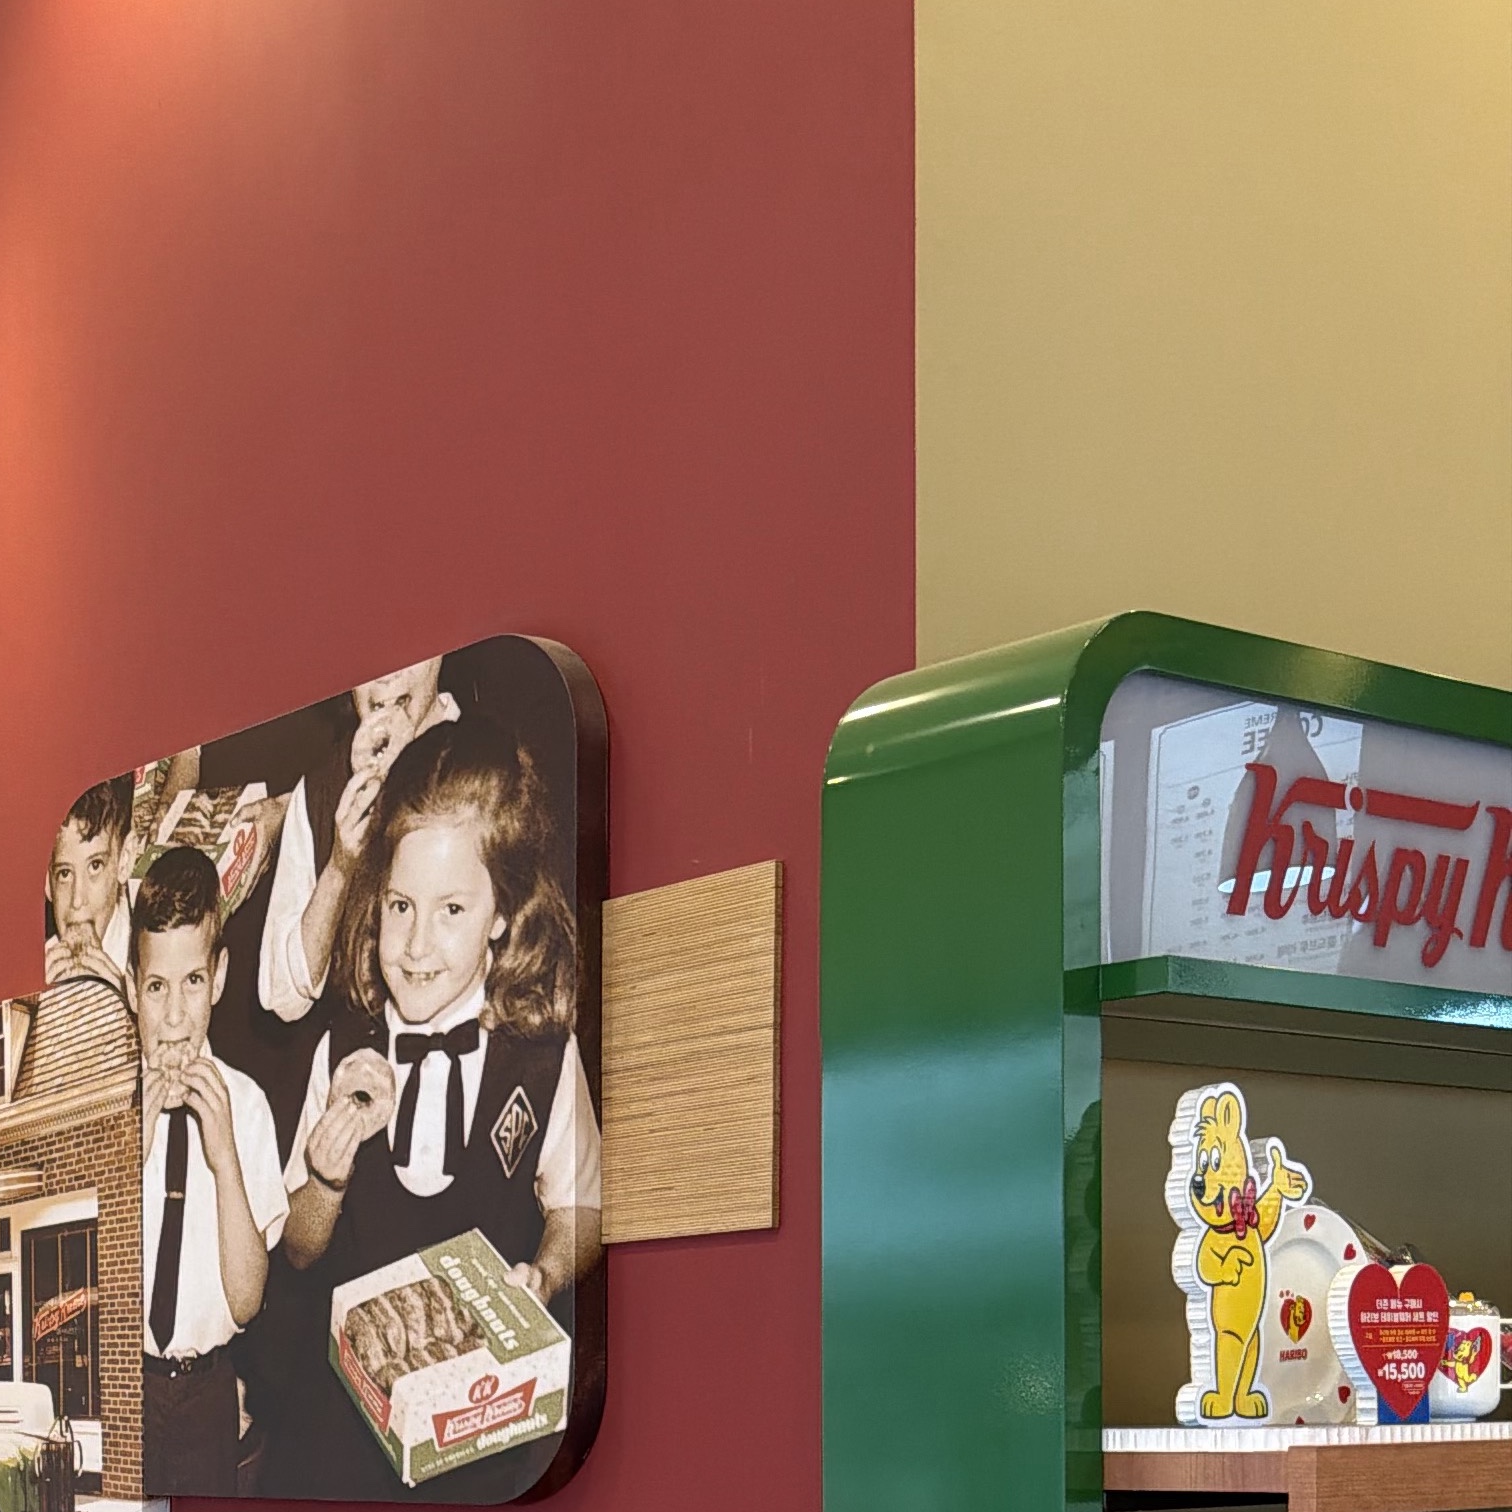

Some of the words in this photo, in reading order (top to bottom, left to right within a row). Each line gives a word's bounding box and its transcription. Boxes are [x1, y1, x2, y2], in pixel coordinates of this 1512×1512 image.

[1226, 762, 1480, 969] Krispy
[439, 1254, 520, 1351] doughnuts
[1279, 1348, 1308, 1362] HARIBO
